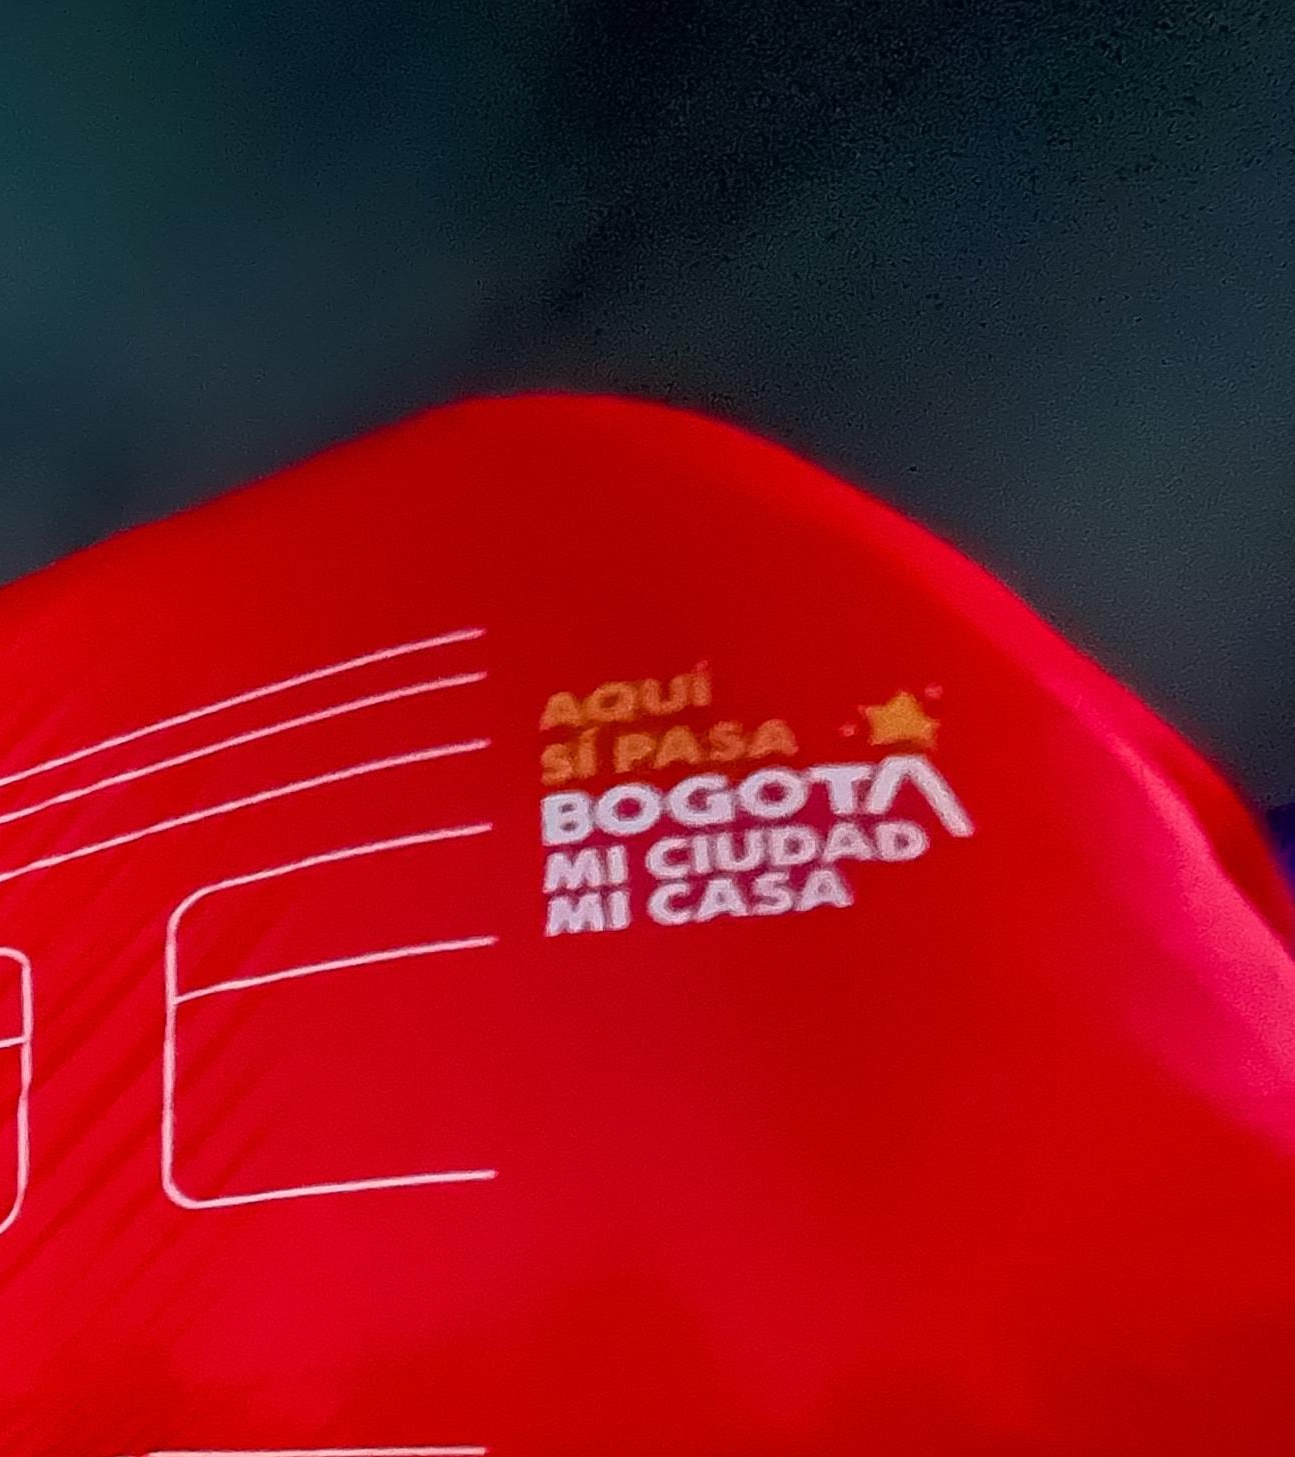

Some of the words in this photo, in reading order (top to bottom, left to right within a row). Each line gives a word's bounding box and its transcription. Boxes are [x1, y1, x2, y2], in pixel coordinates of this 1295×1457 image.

[613, 719, 799, 774] PASA
[543, 844, 629, 894] MI
[645, 820, 929, 881] CIUDAD
[545, 890, 631, 937] MI
[646, 867, 855, 927] CASA
